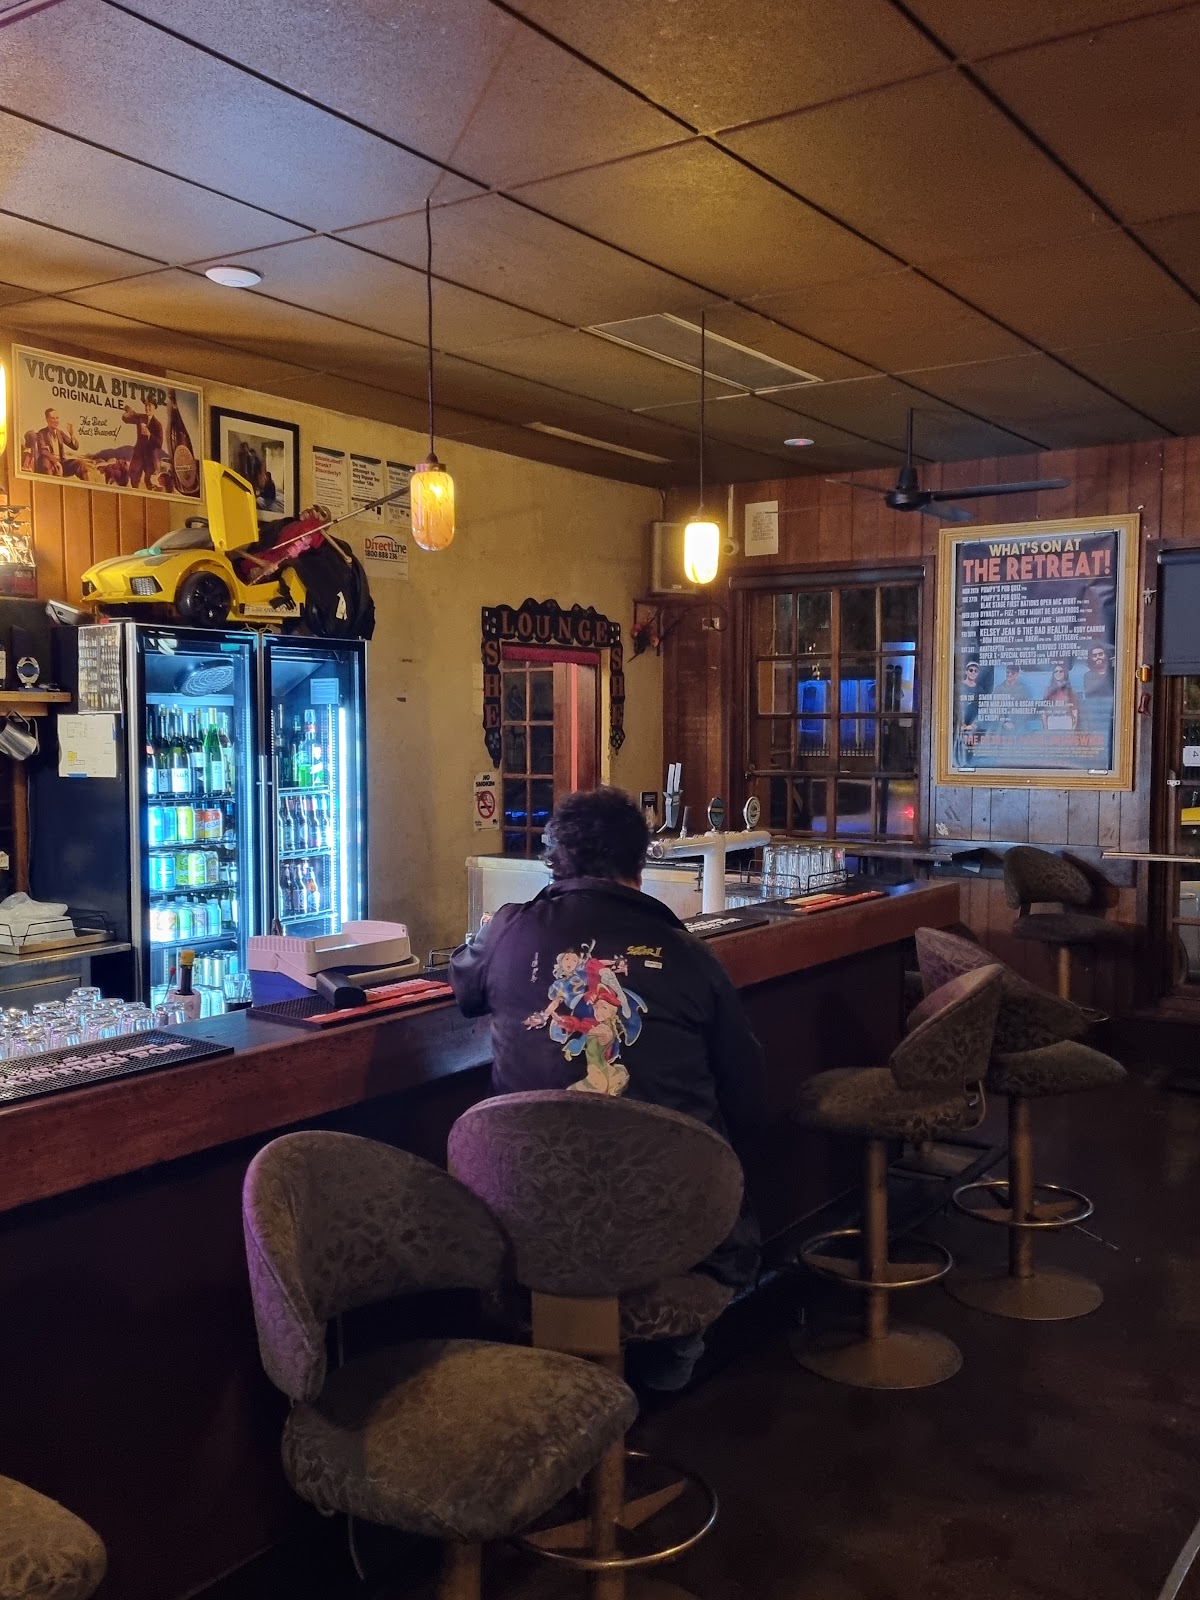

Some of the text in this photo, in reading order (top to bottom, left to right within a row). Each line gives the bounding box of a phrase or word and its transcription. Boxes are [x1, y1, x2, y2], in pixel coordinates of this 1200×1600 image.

[25, 357, 167, 407] VICTORIA BITTER
[52, 386, 124, 410] ORIGINAL ALE
[79, 415, 107, 427] The Best
[315, 460, 331, 468] Drunk?
[315, 467, 341, 477] Disorderly?
[365, 538, 407, 554] DirectLine
[989, 538, 1082, 557] WHAT'S ON AT
[365, 550, 378, 558] 1800
[378, 551, 389, 559] 888
[963, 549, 1112, 583] THE RETREAT!
[1018, 608, 1028, 616] THEY
[501, 610, 608, 643] LOUNGE
[980, 628, 1000, 637] KELSEY
[1001, 627, 1015, 636] JEAN
[1023, 626, 1033, 636] THE
[1034, 626, 1046, 635] BAD
[1047, 625, 1069, 634] HEALTH
